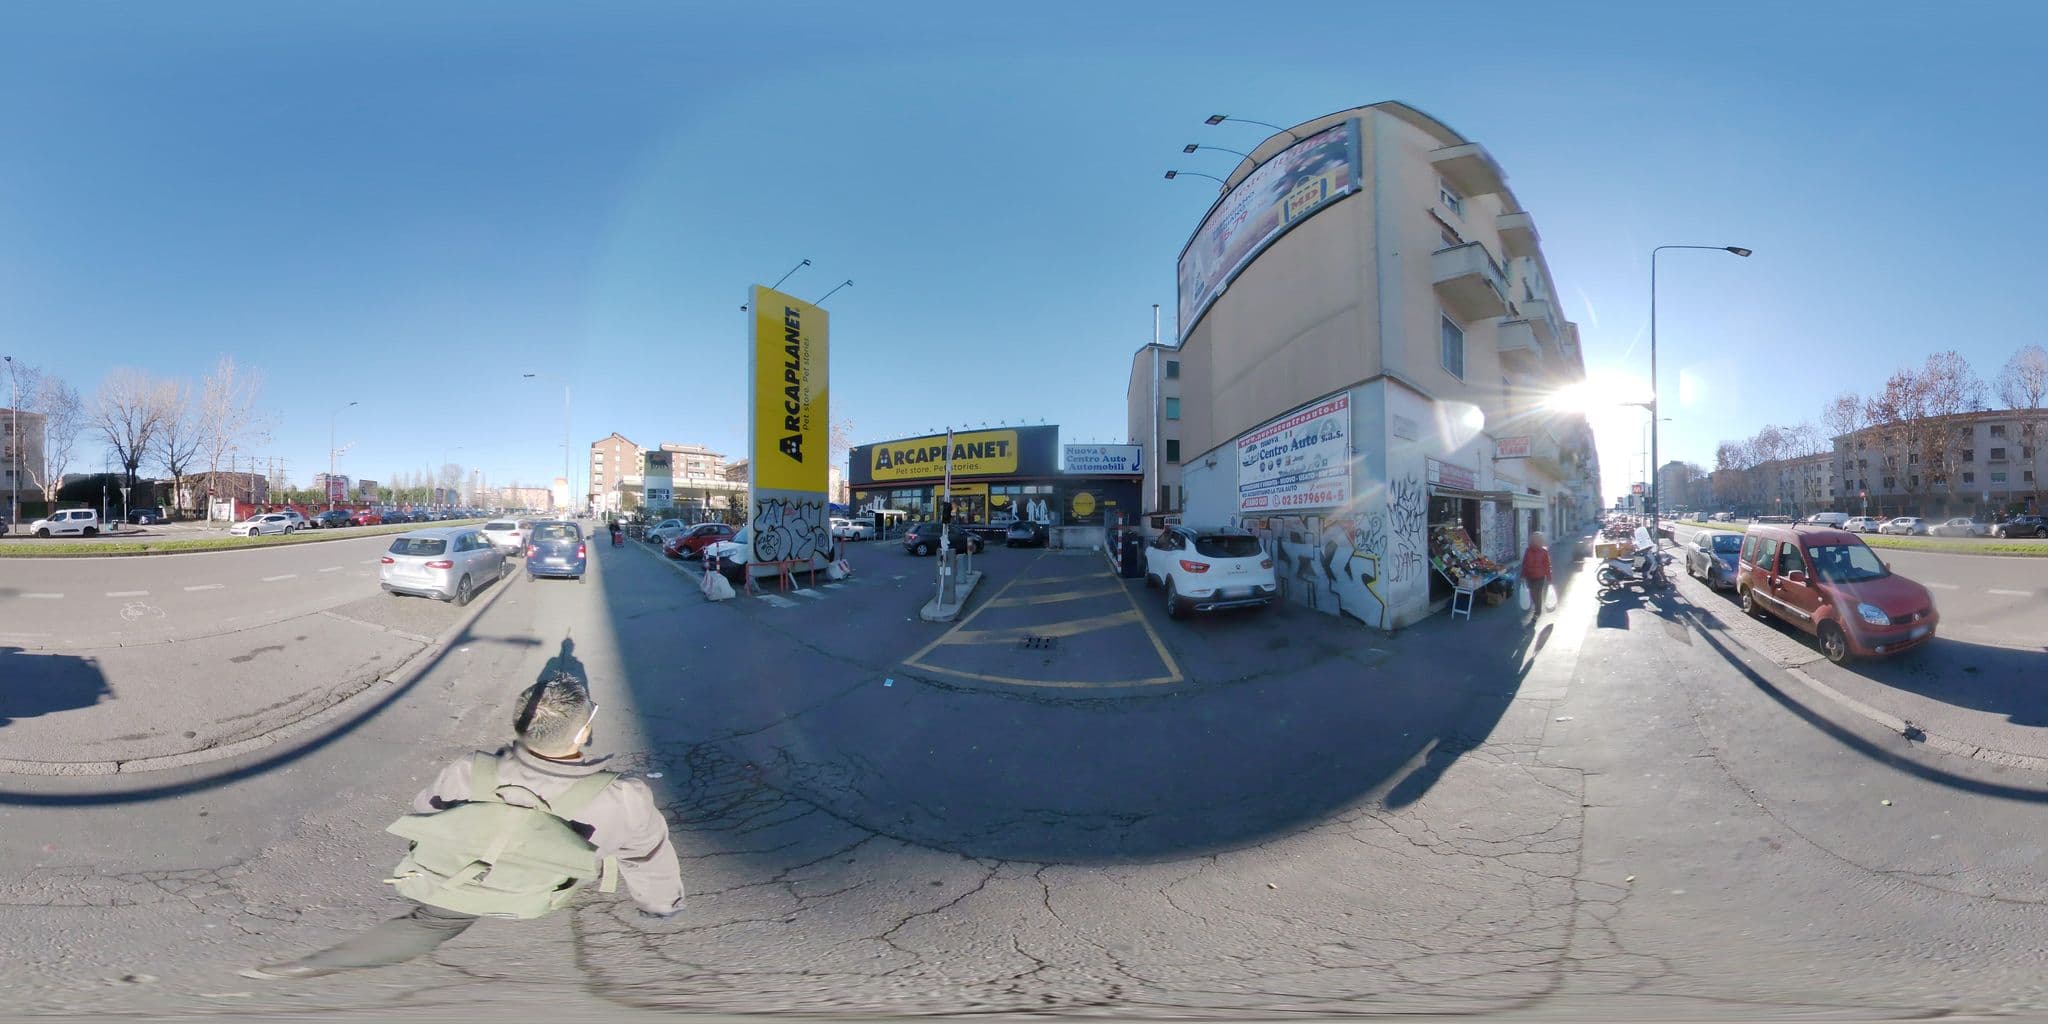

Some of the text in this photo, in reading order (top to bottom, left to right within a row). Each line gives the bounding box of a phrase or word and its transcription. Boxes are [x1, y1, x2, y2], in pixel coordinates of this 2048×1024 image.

[779, 306, 803, 463] ARCAPLANET
[1066, 447, 1098, 455] Nuova
[1259, 444, 1288, 460] Centro
[1290, 434, 1318, 453] Auto
[1066, 455, 1127, 463] Centro Auto
[896, 467, 908, 475] Pet
[909, 466, 932, 474] store.
[1069, 463, 1125, 471] Automobili
[1282, 495, 1291, 505] 02
